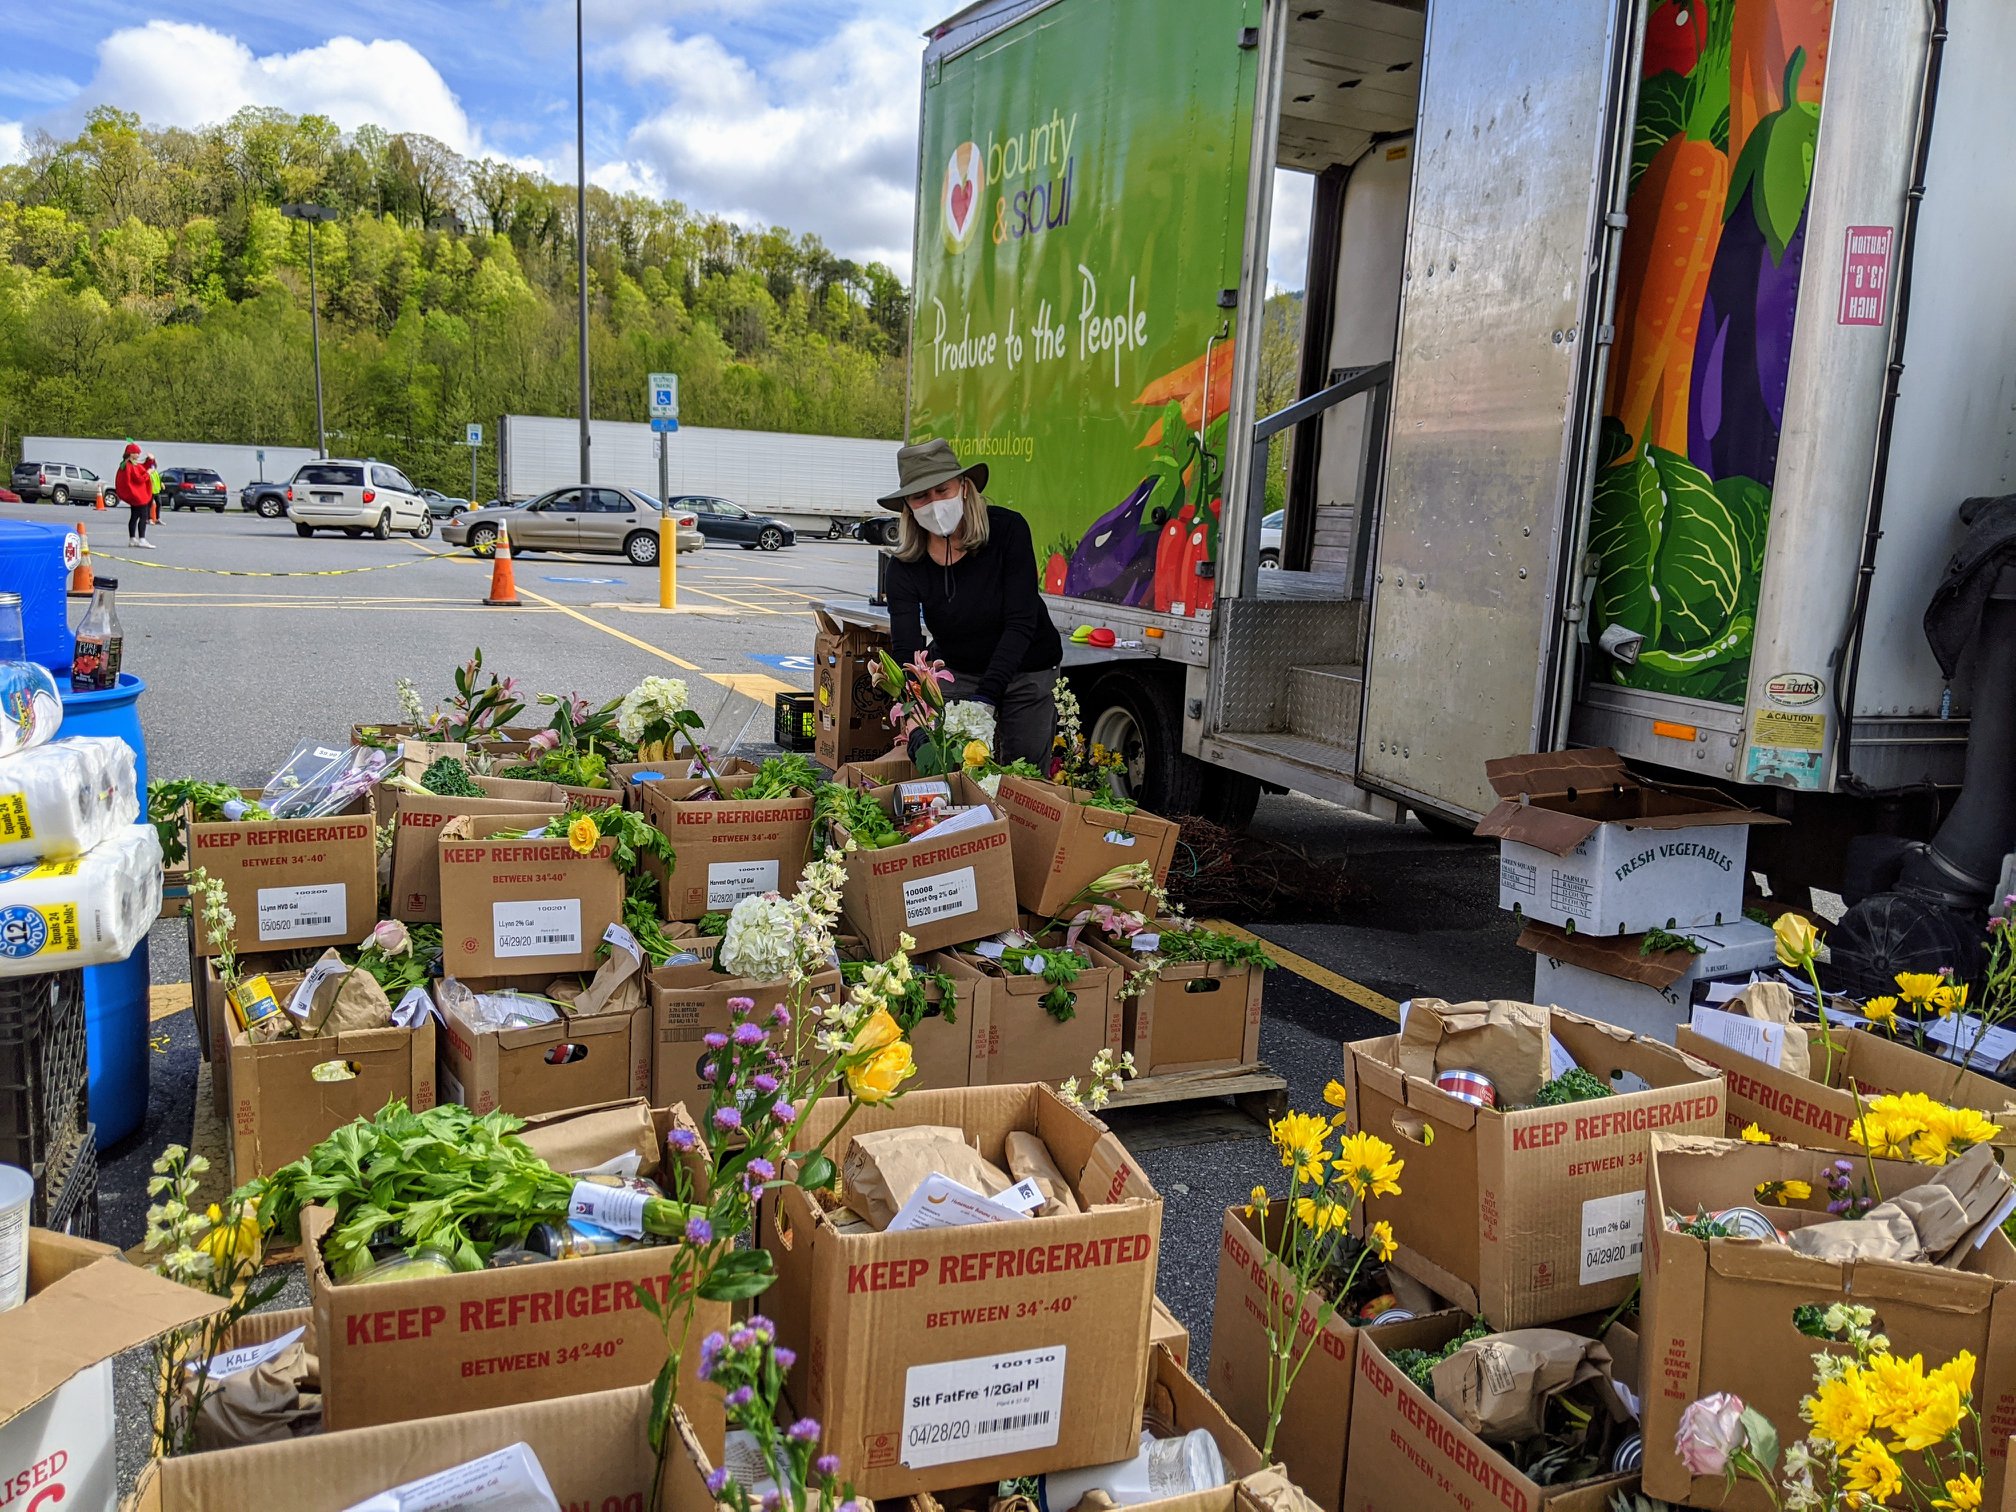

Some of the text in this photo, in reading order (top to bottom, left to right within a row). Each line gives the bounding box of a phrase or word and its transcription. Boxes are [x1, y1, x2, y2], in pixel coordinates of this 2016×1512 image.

[986, 108, 1077, 186] bounty
[992, 156, 1073, 245] & soul
[934, 264, 1147, 387] Produce to the People
[1774, 713, 1814, 722] CAUTION
[677, 807, 811, 825] KEEP REFRIGERATED
[1014, 793, 1061, 823] REFRIGERATED
[1, 802, 14, 835] Equals 24
[15, 814, 29, 840] Regular
[402, 812, 443, 828] KEEP
[197, 825, 367, 849] KEEP REFRIGERATED
[712, 835, 749, 843] BETWEEN
[242, 857, 288, 867] BETWEEN
[444, 848, 486, 863] KEEP
[872, 832, 1007, 876] KEEP REFRIGERATED
[1615, 842, 1734, 882] FRESH VEGETABLES
[493, 875, 533, 883] BETWEEN
[1563, 874, 1589, 885] PARSLEY
[906, 886, 933, 897] 100008
[906, 888, 959, 906] Harvest Org 2% Gal
[908, 906, 931, 919] 05/05/20
[7, 922, 28, 944] 12
[49, 911, 62, 946] Equals 24
[261, 919, 291, 931] 05/05/20
[65, 925, 77, 951] Regular
[499, 936, 532, 947] 04/29/20
[1513, 1121, 1568, 1150] KEEP
[1575, 1095, 1718, 1141] REFRIGERATED
[1568, 1155, 1624, 1176] BETWEEN
[1484, 1200, 1496, 1208] NOT
[1485, 1190, 1495, 1200] DO
[1481, 1204, 1498, 1217] STACK
[1482, 1214, 1498, 1226] OVER
[1587, 1219, 1631, 1237] LLynn 2% Gal
[1225, 1230, 1250, 1270] KEEP
[1586, 1245, 1625, 1268] 04/29/20
[847, 1233, 1152, 1294] KEEP REFRIGERATED
[347, 1271, 696, 1346] KEEP REFRIGERATE
[927, 1305, 1009, 1329] BETWEEN
[1672, 1338, 1685, 1348] DO
[226, 1349, 260, 1367] KALE
[992, 1355, 1056, 1370] 100130
[1669, 1348, 1687, 1358] NOT
[461, 1351, 550, 1377] BETWEEN
[1664, 1358, 1692, 1370] STACK
[1665, 1368, 1688, 1380] OVER
[935, 1387, 979, 1406] FatFre
[983, 1381, 1023, 1399] 1/2Gal
[909, 1420, 970, 1447] 04/28/20
[1360, 1349, 1394, 1398] KEEP
[1398, 1388, 1528, 1512] REFRIGERATED
[1390, 1428, 1434, 1479] BETWEEN
